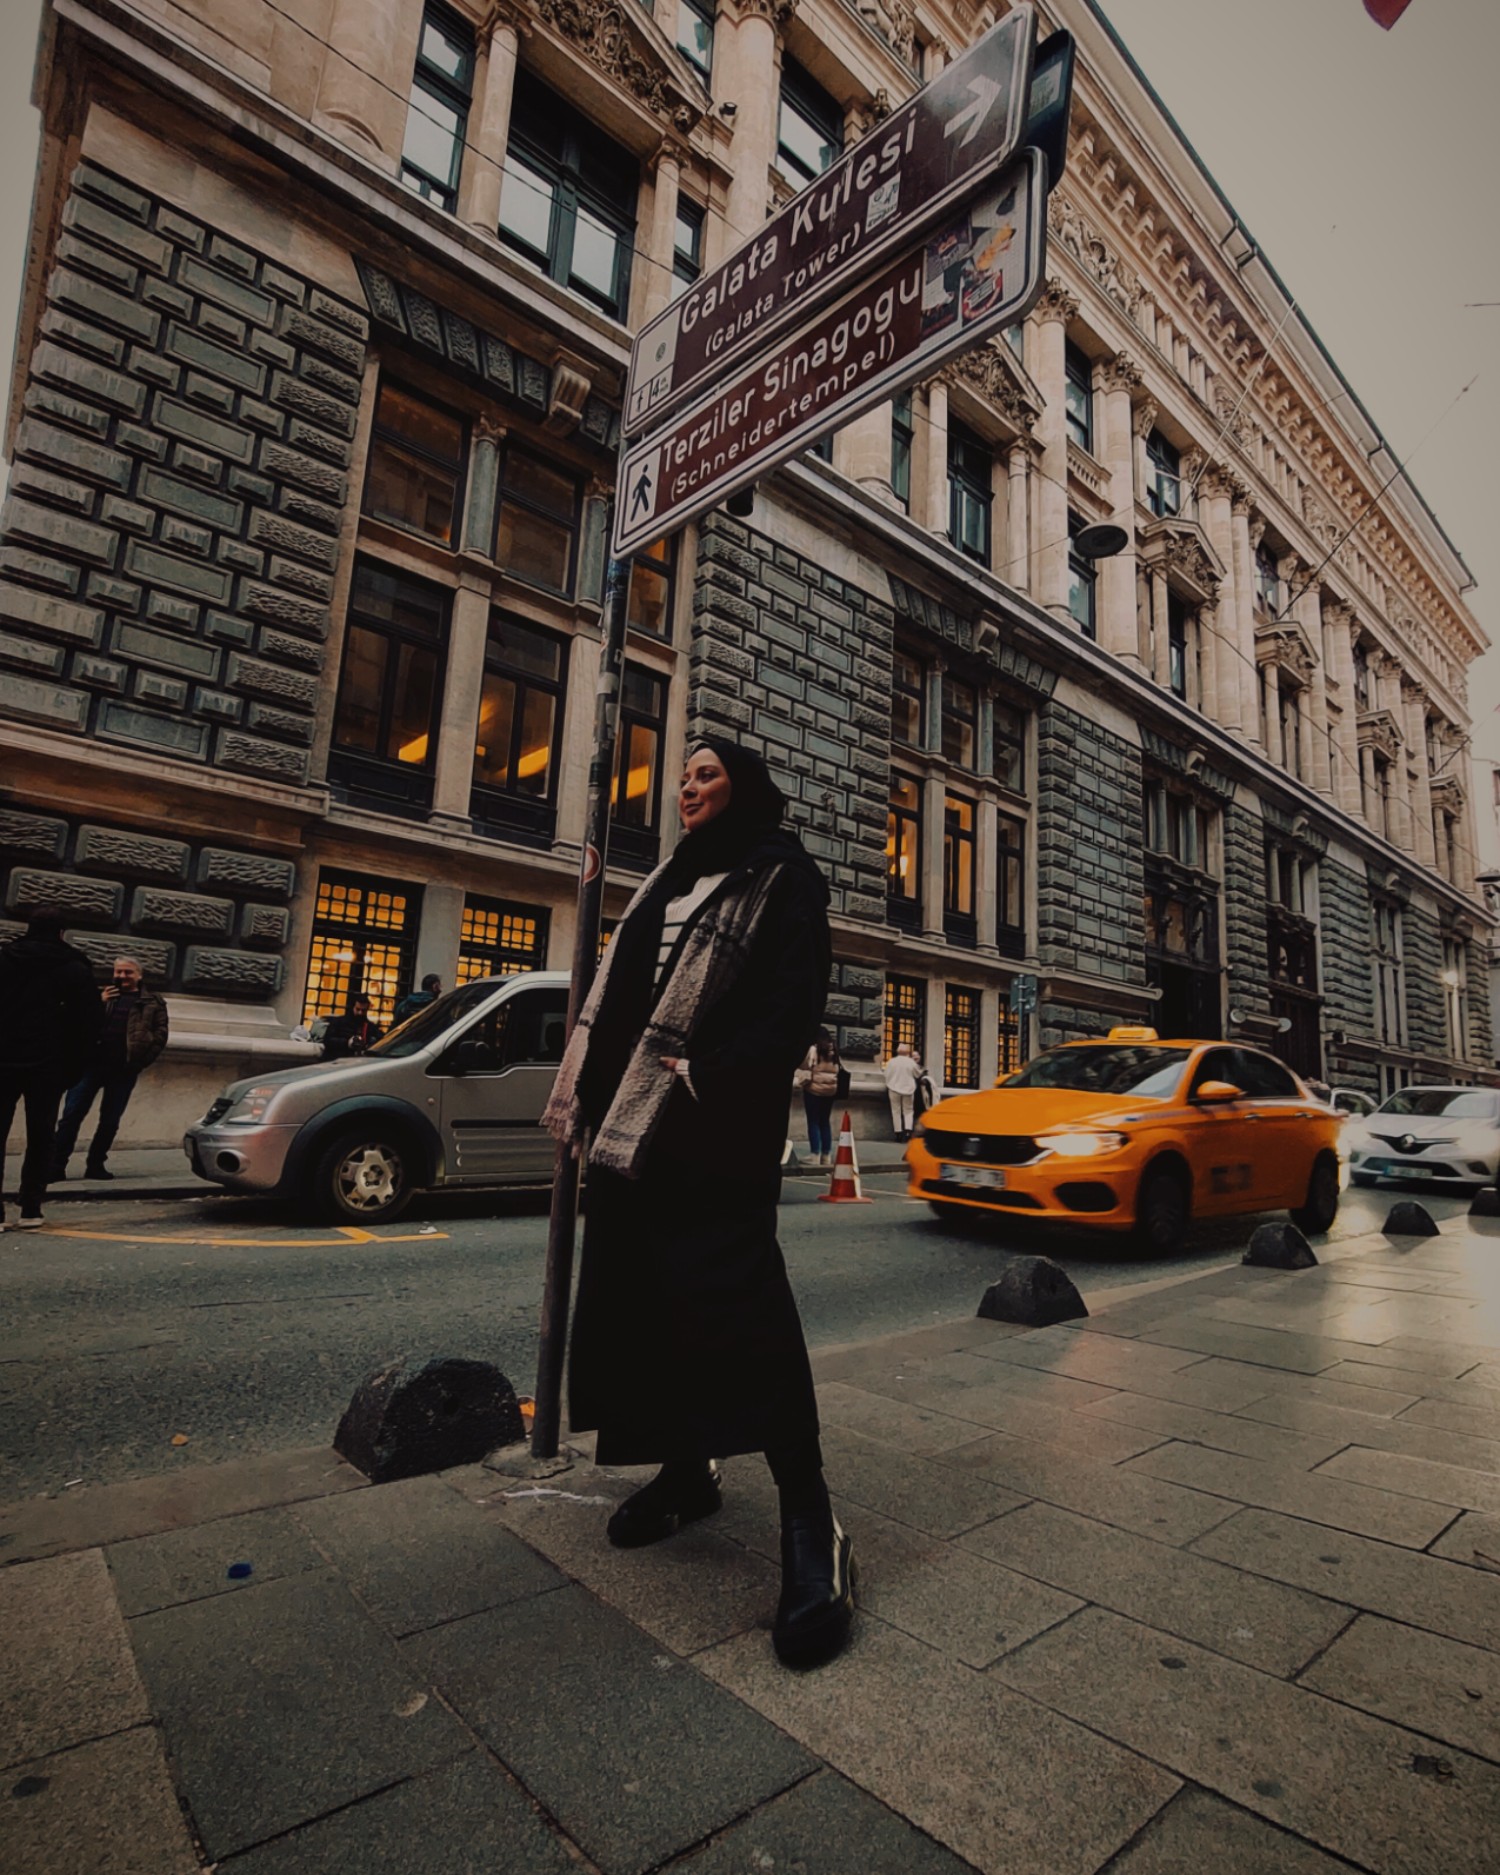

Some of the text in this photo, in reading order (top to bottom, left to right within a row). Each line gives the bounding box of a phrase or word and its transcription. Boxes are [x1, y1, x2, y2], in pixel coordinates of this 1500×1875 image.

[681, 108, 916, 333] Galata Kulesi
[705, 221, 861, 358] (Galata Tower)
[663, 267, 920, 473] Terziler Sinagogu
[671, 330, 895, 502] (Schneidertempel)
